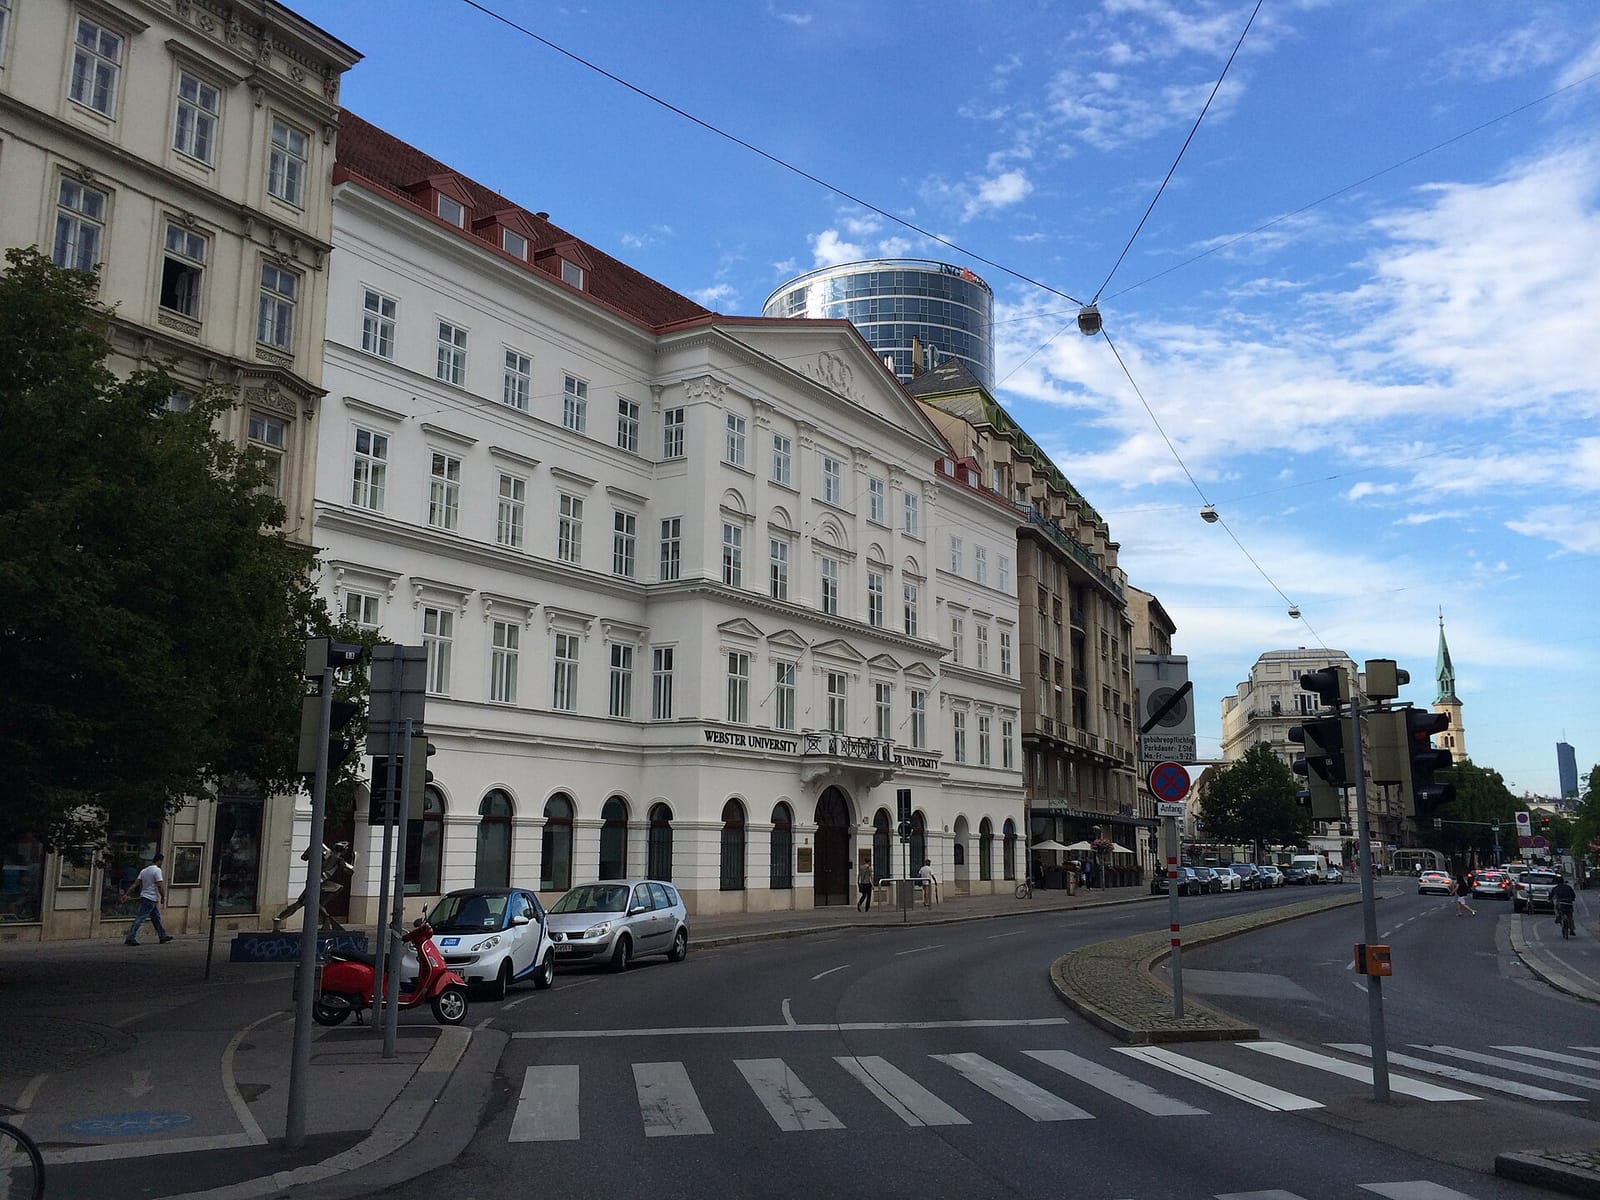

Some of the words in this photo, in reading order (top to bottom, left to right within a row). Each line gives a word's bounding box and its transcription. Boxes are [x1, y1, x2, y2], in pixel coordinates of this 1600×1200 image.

[704, 730, 747, 746] WEBSTER
[748, 736, 798, 753] UNIVERSITY
[903, 755, 939, 769] UNIVERSITY
[1160, 804, 1183, 814] Anfang
